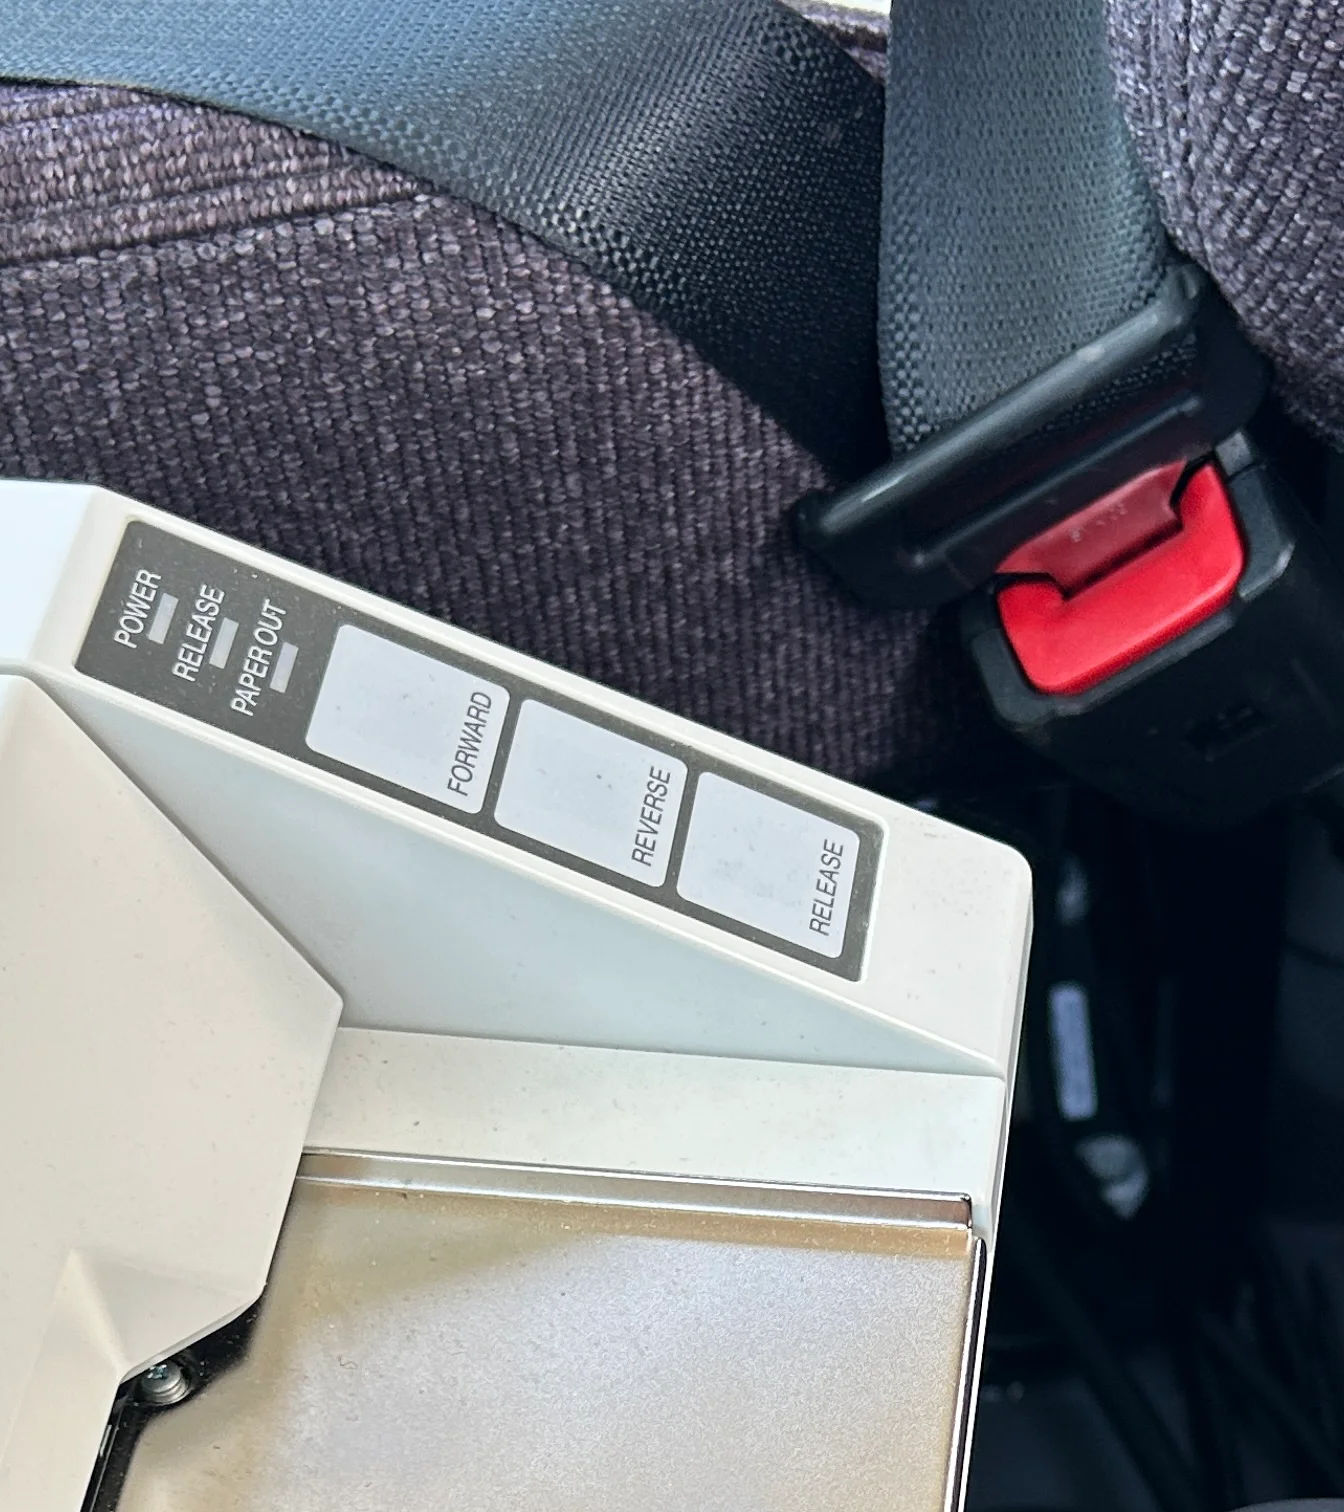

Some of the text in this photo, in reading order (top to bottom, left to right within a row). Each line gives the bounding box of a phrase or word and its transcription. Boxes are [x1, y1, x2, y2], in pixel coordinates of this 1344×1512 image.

[113, 568, 163, 649] POWER
[173, 584, 225, 682] RELEASE
[230, 598, 287, 717] PAPER OUT
[447, 690, 493, 796] FORWARD
[631, 765, 671, 867] REVERSE
[809, 839, 845, 936] RELEASE
